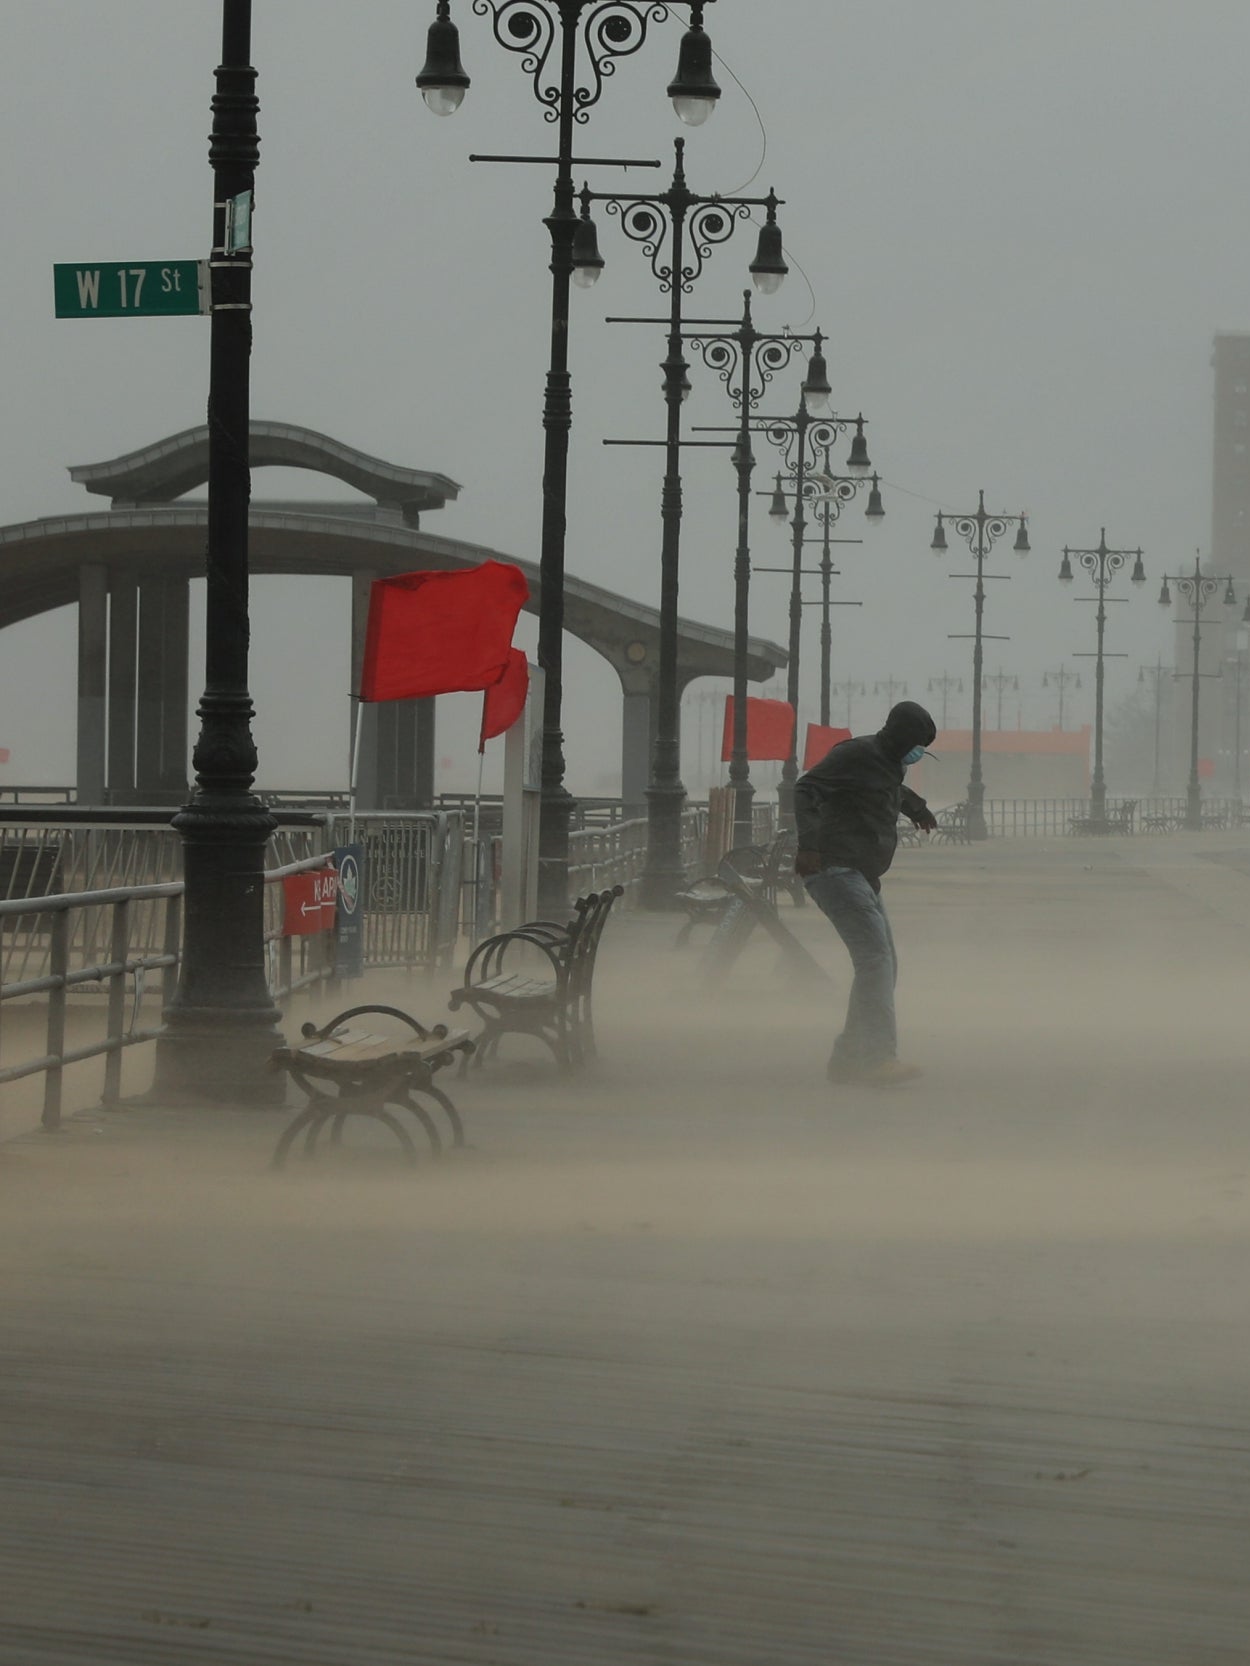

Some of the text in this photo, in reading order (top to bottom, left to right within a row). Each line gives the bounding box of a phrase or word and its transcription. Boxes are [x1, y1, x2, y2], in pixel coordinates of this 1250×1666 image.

[76, 268, 181, 309] W 17 St
